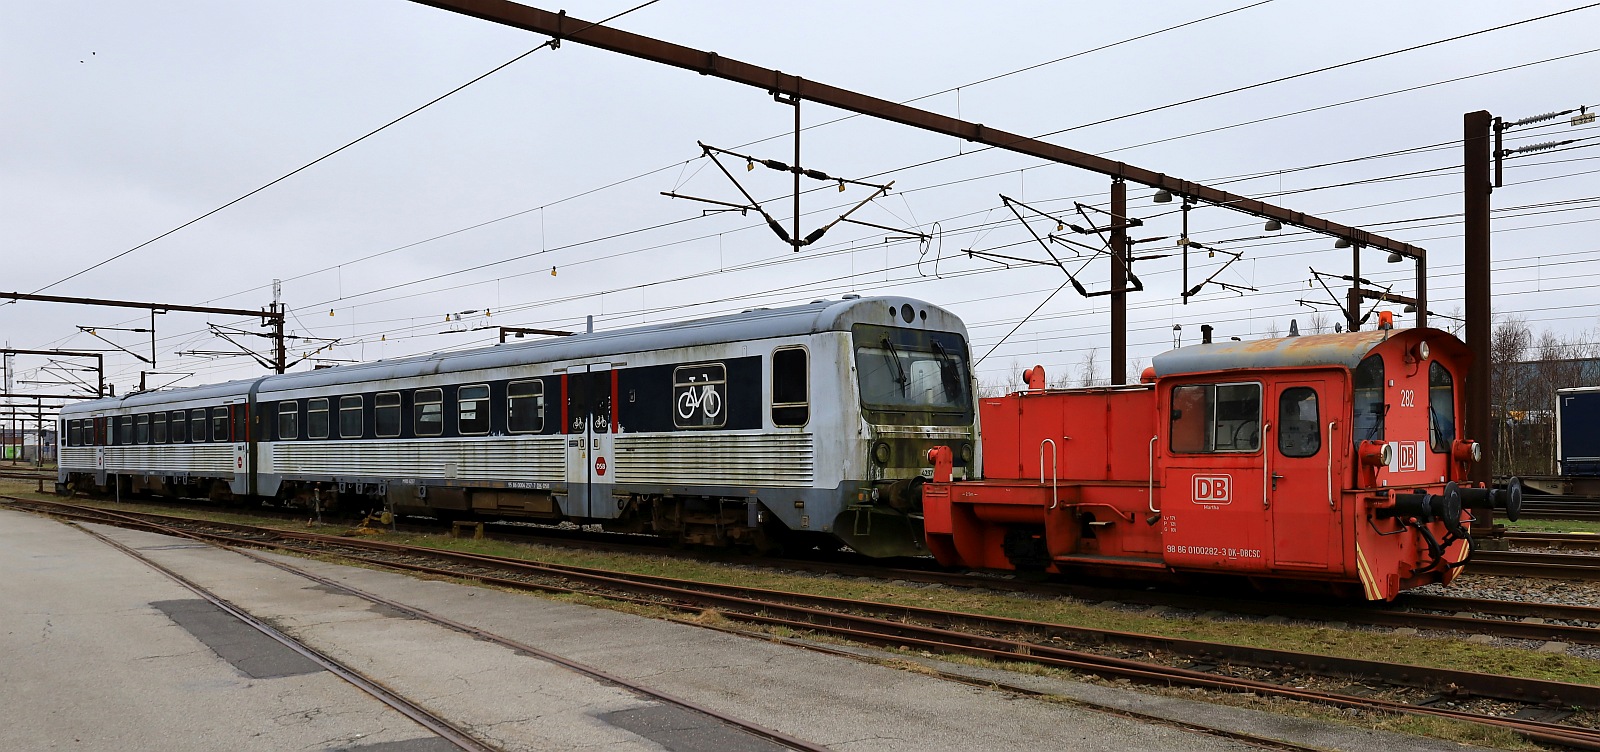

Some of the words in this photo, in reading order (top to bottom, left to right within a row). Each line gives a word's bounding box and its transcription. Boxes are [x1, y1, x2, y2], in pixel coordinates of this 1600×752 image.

[1400, 389, 1415, 408] 282
[1401, 445, 1414, 468] DB
[1196, 478, 1228, 500] DB
[1167, 544, 1176, 553] 98
[1178, 545, 1187, 554] 86
[1188, 546, 1227, 556] 0100282-3
[1228, 548, 1261, 559] DK-DBCSC
